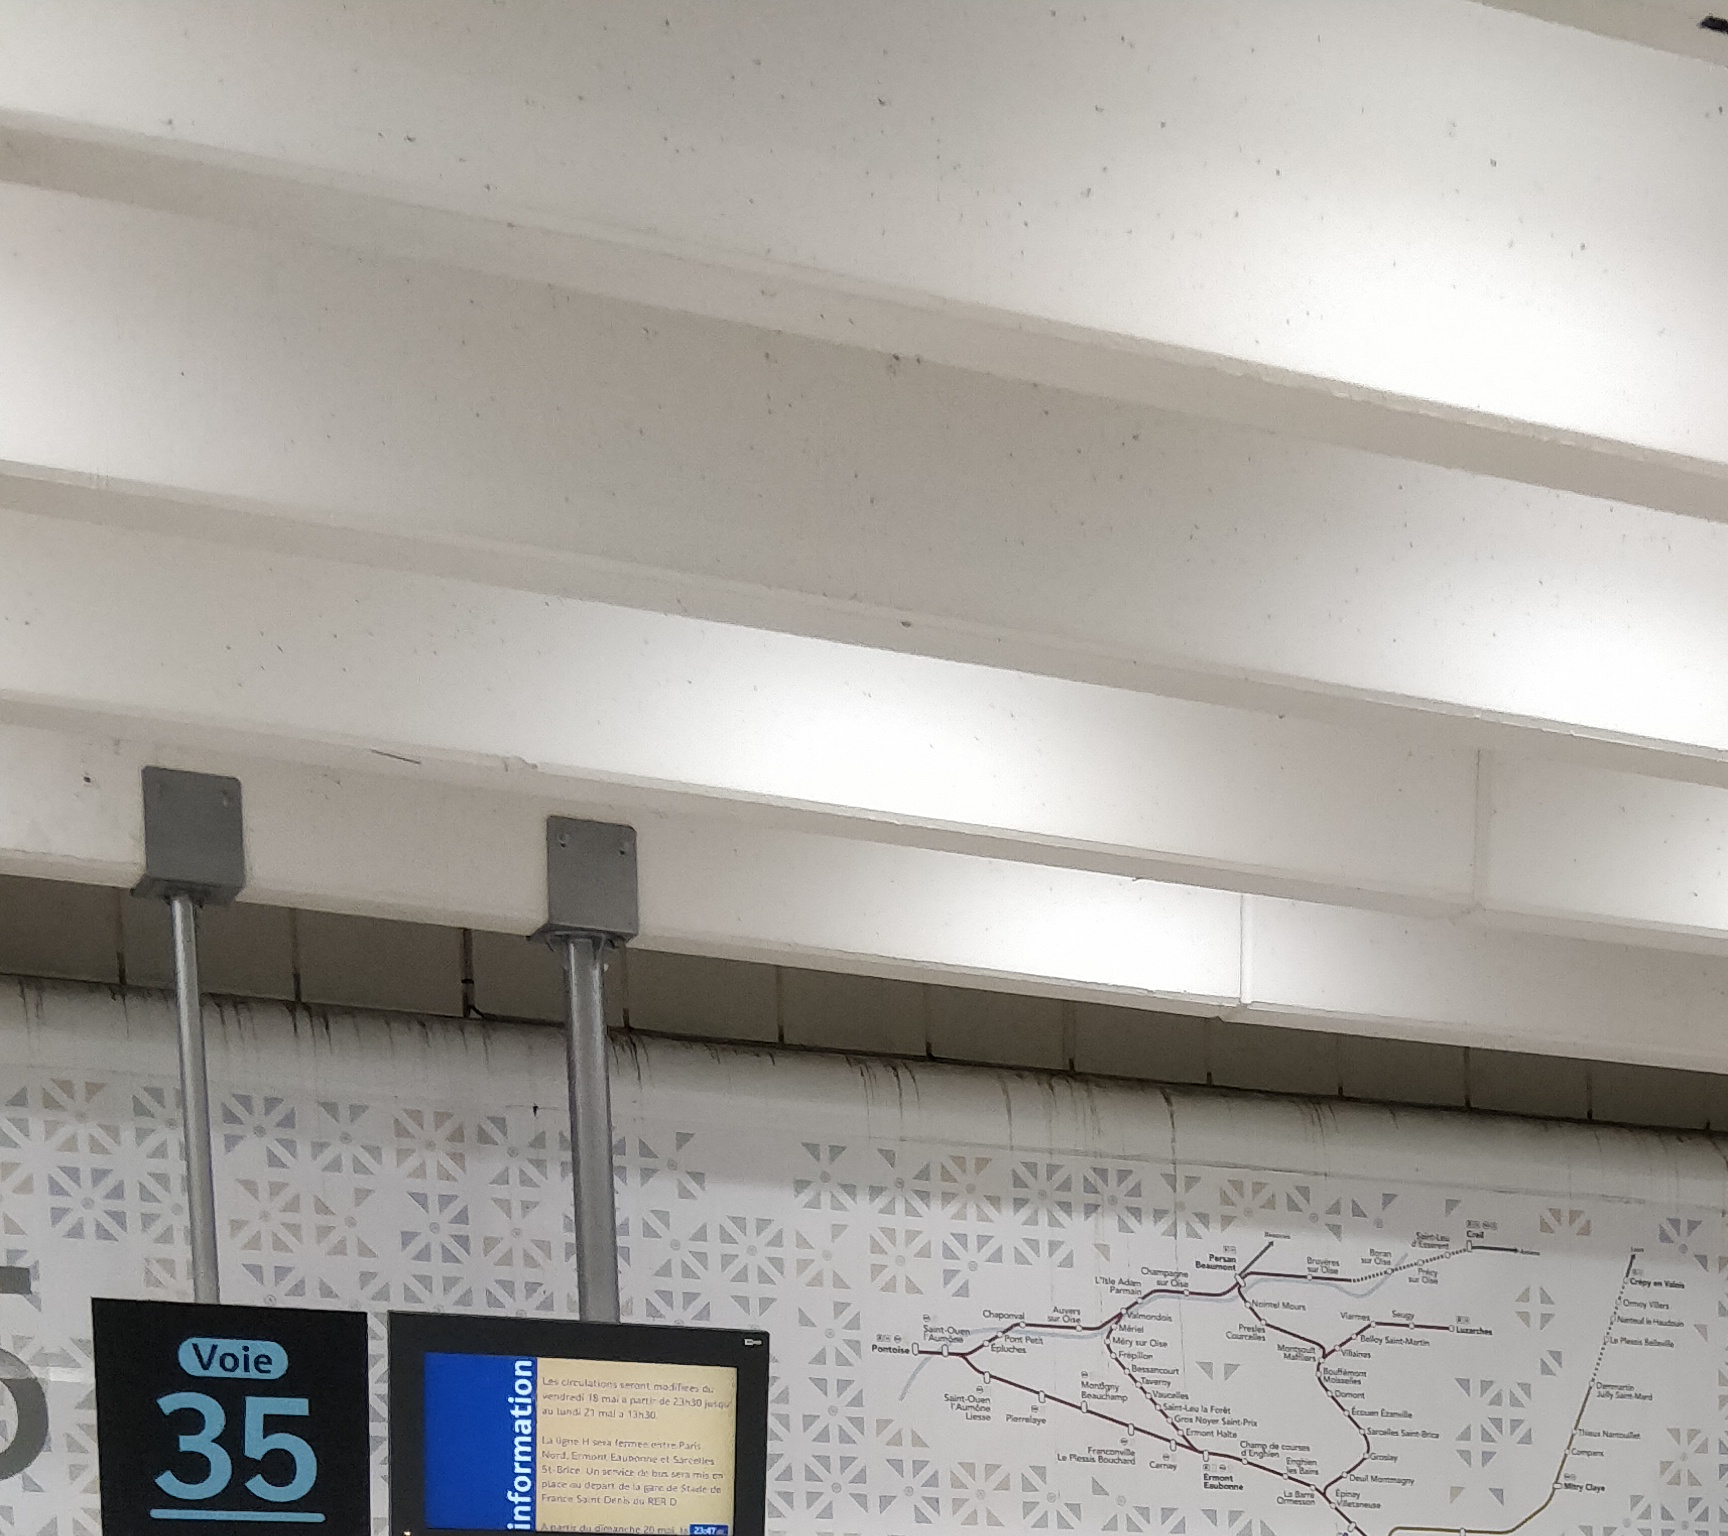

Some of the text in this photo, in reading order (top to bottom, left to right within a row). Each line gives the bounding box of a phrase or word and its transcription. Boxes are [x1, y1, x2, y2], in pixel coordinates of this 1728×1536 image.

[192, 1341, 274, 1375] Voie
[154, 1391, 319, 1502] 35
[507, 1359, 534, 1530] information
